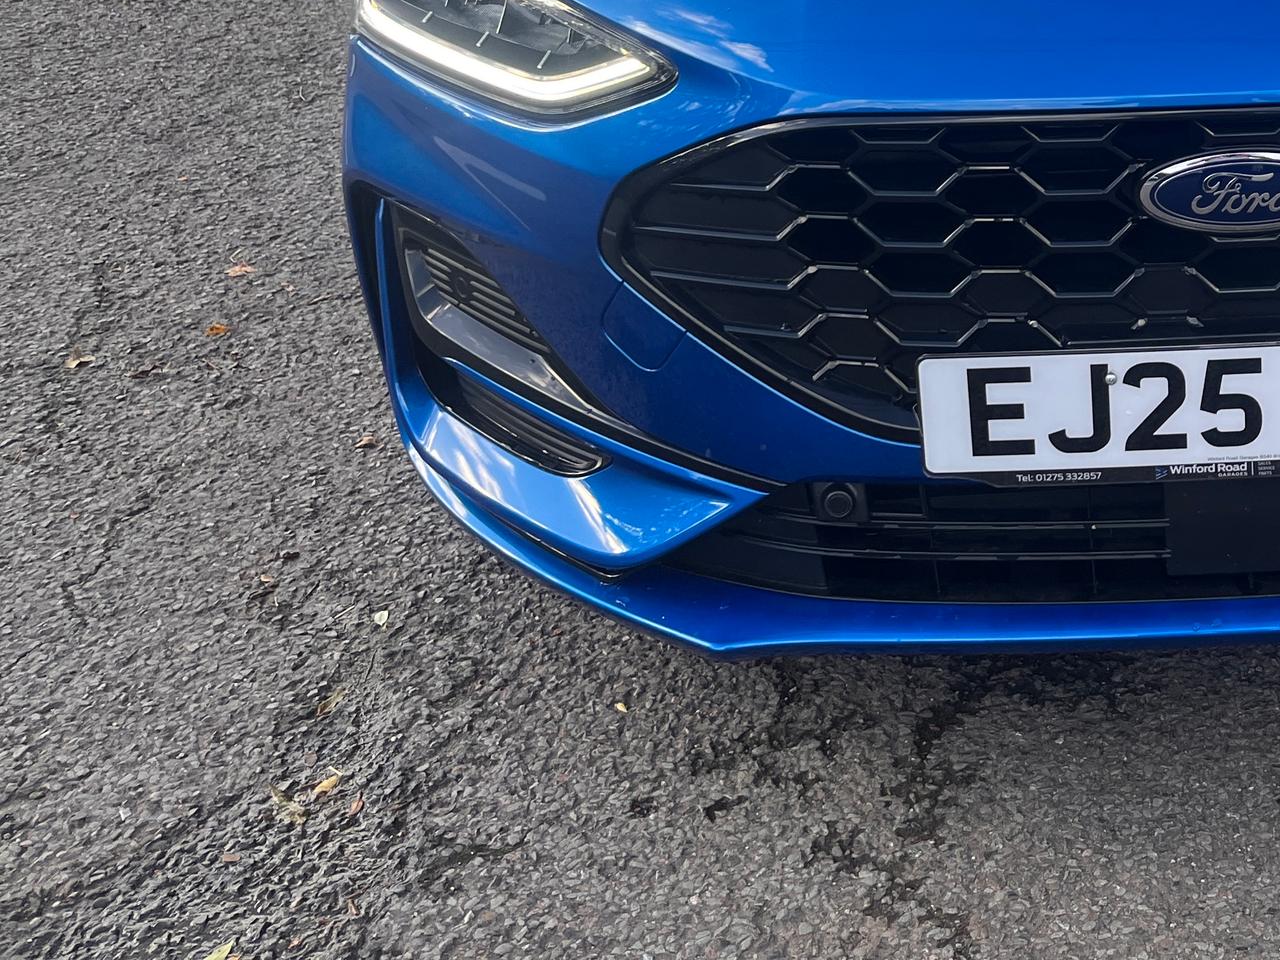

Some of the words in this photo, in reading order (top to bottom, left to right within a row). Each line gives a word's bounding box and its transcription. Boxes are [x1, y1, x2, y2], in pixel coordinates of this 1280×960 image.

[966, 358, 1263, 457] EJ25
[1169, 462, 1216, 476] Winford
[1217, 461, 1248, 472] Road
[1016, 474, 1034, 482] Tel:
[1035, 472, 1064, 482] 01275
[1065, 471, 1102, 481] 332857
